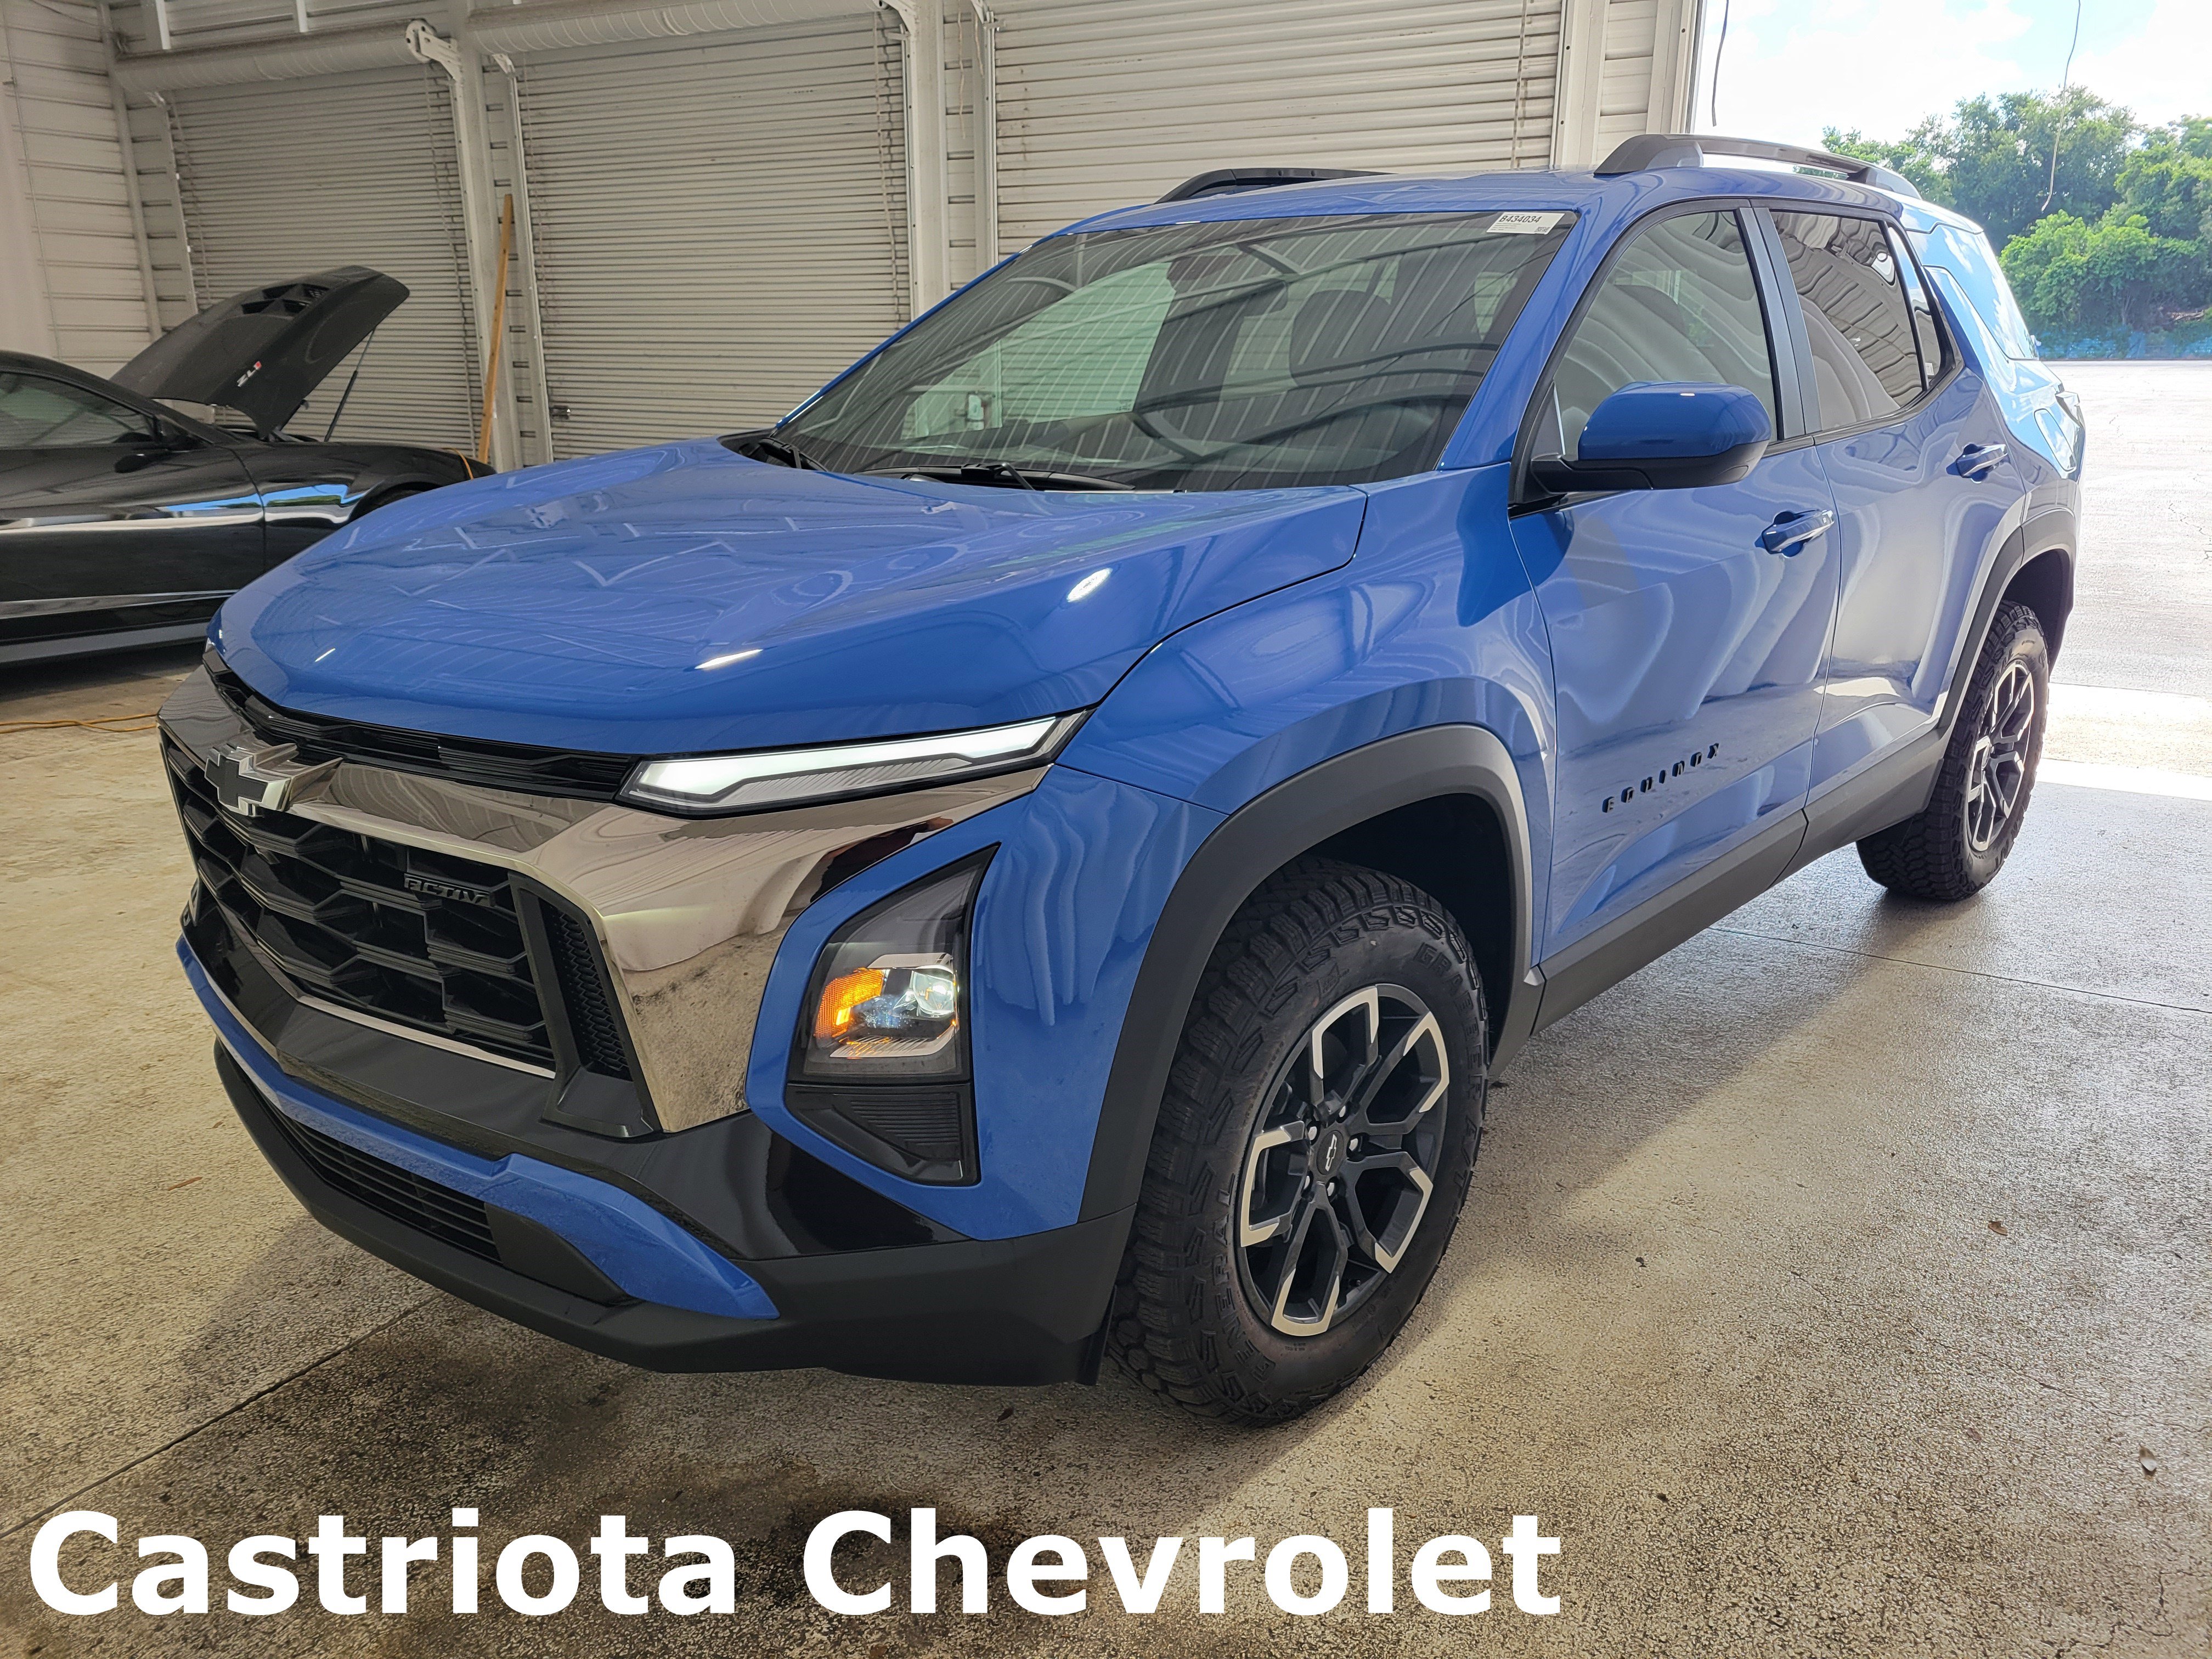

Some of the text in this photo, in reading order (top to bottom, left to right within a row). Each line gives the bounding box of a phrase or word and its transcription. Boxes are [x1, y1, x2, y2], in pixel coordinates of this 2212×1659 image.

[1602, 743, 1719, 813] EQUINOX
[404, 877, 490, 906] ACTIV
[1212, 1173, 1276, 1383] GENERAL
